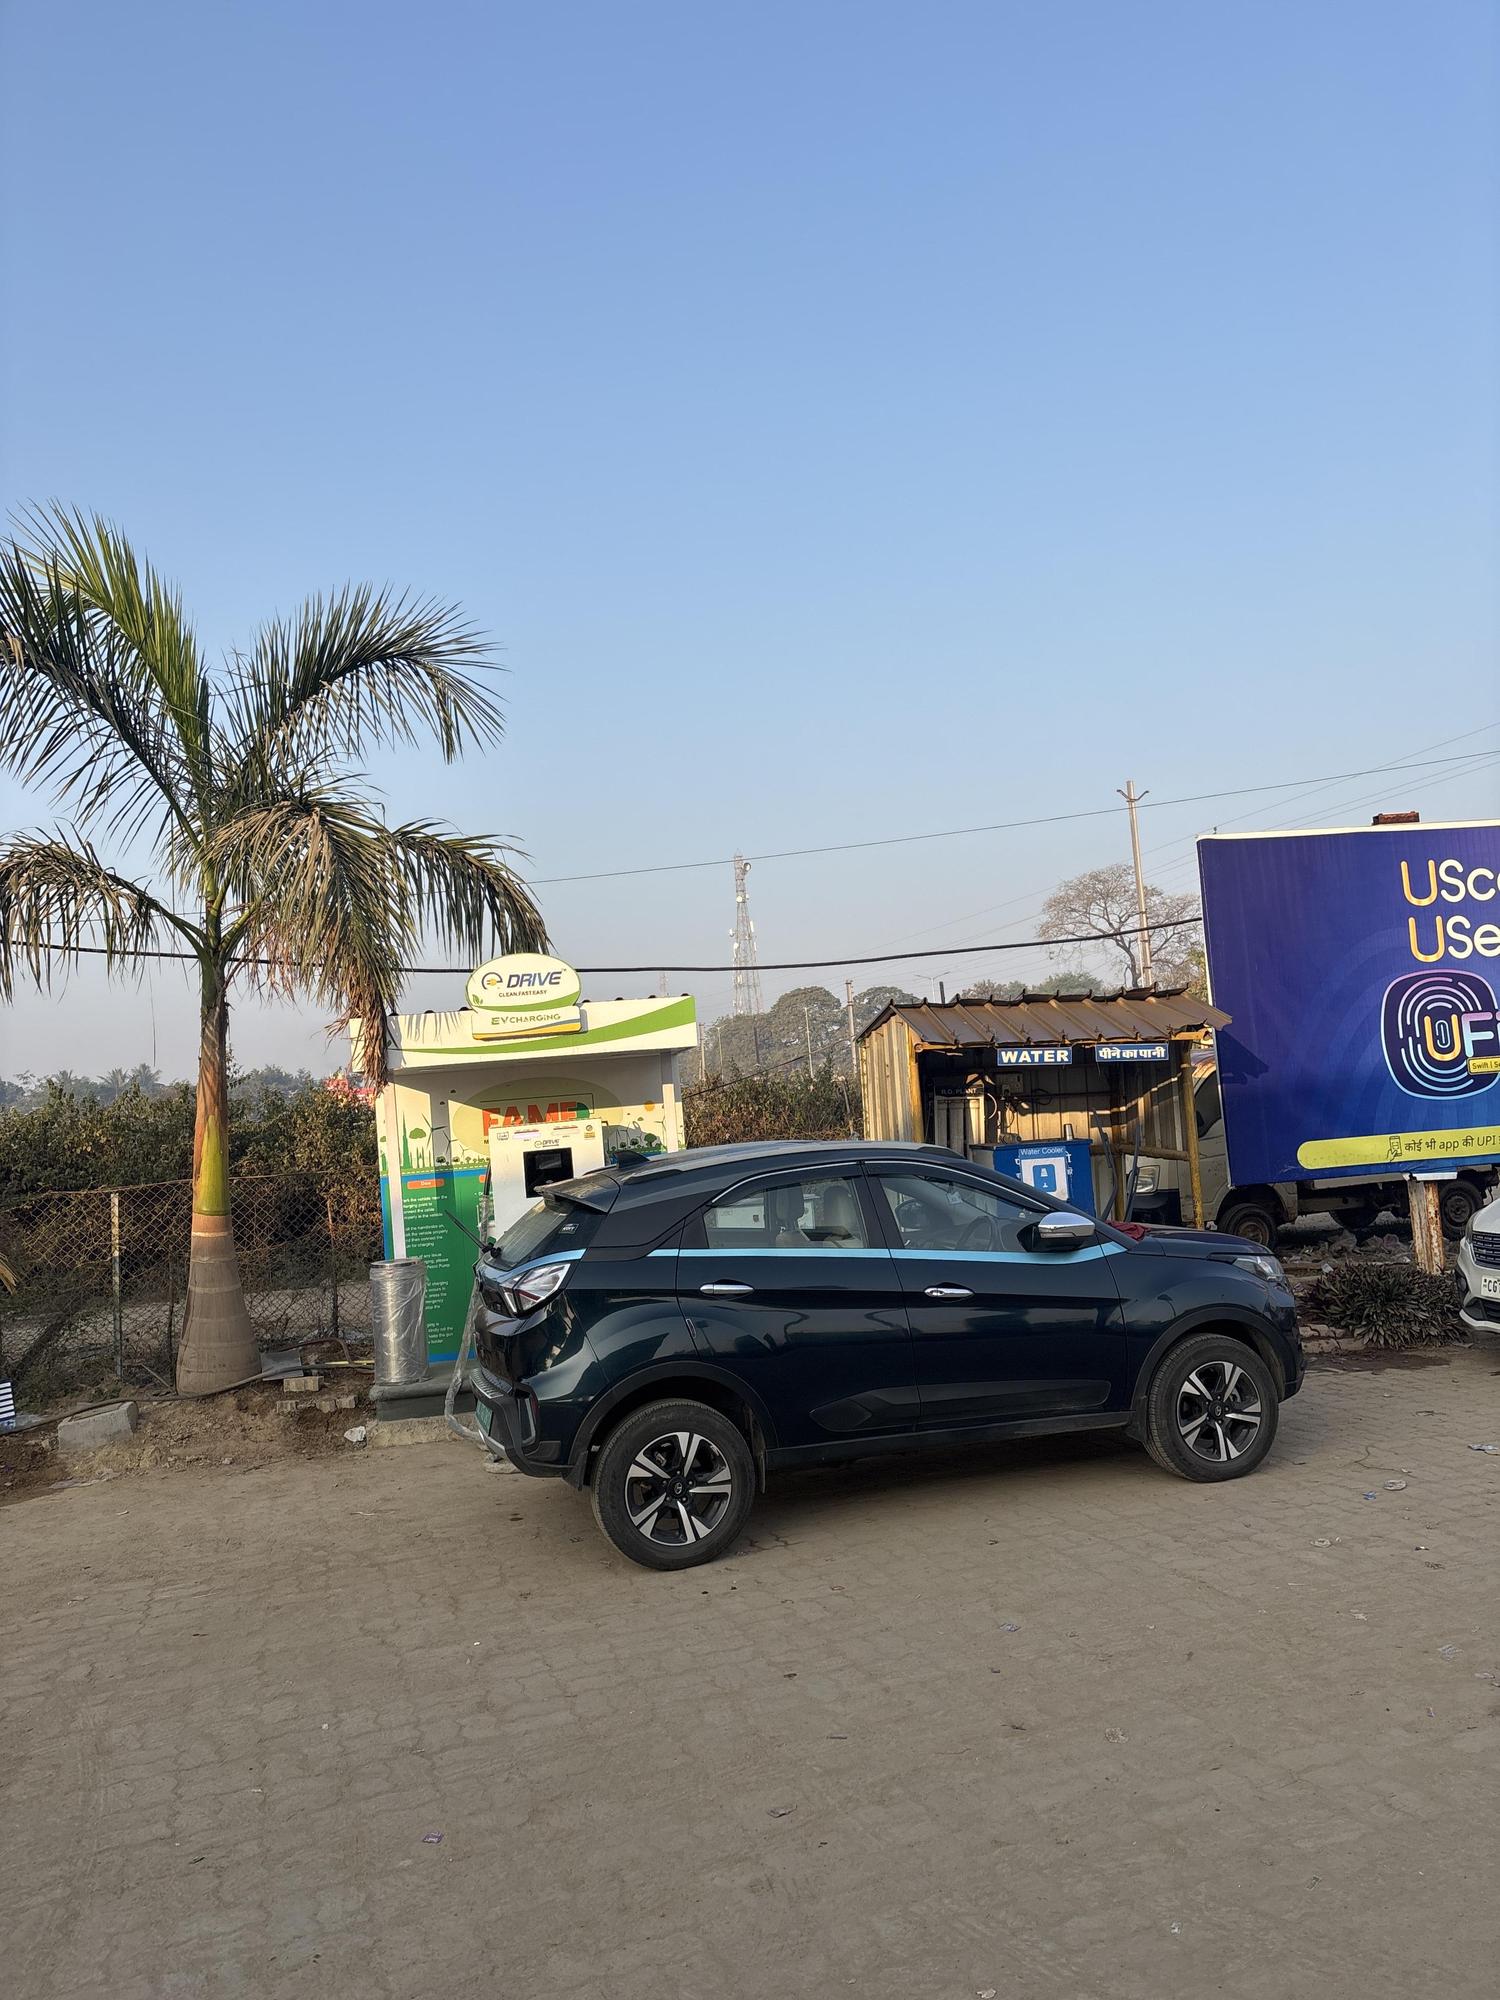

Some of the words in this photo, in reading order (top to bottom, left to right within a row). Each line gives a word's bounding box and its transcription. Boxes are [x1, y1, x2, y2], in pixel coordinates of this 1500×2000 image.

[1401, 859, 1500, 906] USc
[506, 971, 562, 988] DRIVE
[1001, 1050, 1069, 1063] WATER
[1099, 1047, 1121, 1060] पीने
[1122, 1048, 1137, 1059] का
[1138, 1046, 1166, 1059] पानी
[1404, 1138, 1422, 1152] कोई
[1425, 1138, 1436, 1150] भी
[1439, 1140, 1460, 1152] app
[1462, 1135, 1474, 1147] की
[1477, 1136, 1496, 1147] UPI
[1020, 1148, 1040, 1156] Water
